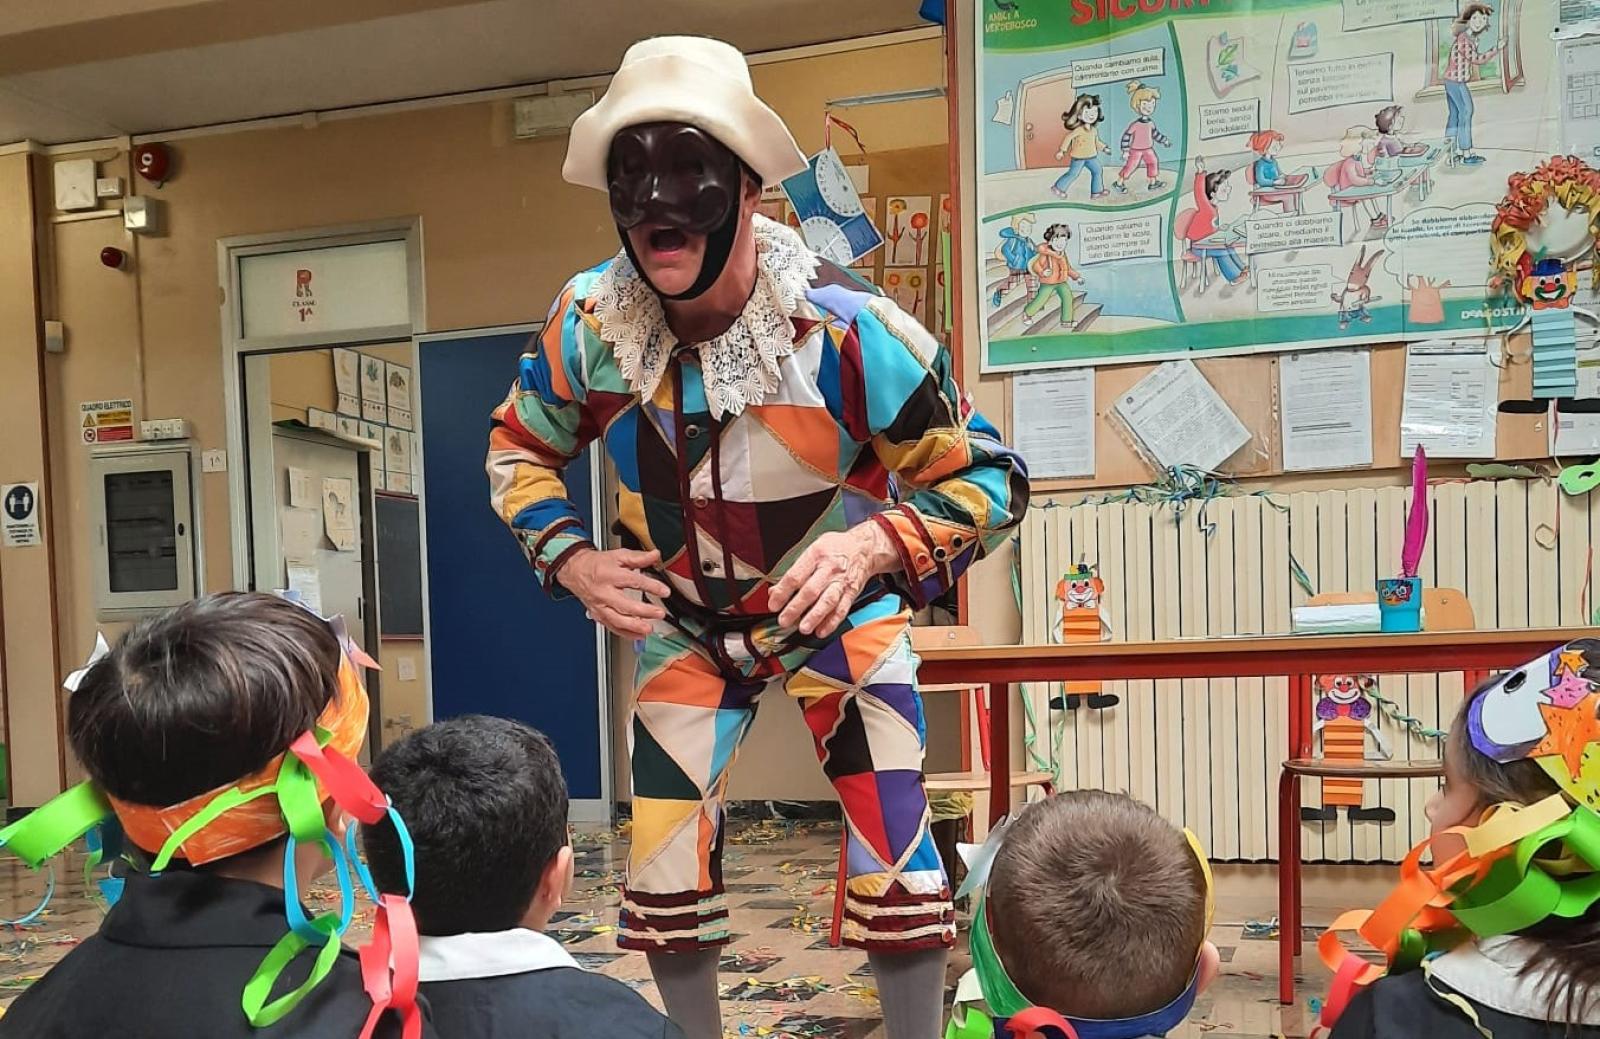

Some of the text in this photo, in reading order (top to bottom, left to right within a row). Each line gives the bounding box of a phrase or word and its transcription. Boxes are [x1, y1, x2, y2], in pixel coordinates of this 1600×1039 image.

[1074, 62, 1102, 72] Quando
[1085, 225, 1114, 234] Quando
[1253, 221, 1284, 231] Quando
[1284, 226, 1323, 237] chiediamo
[81, 400, 132, 412] QUADRO ELETTRICO
